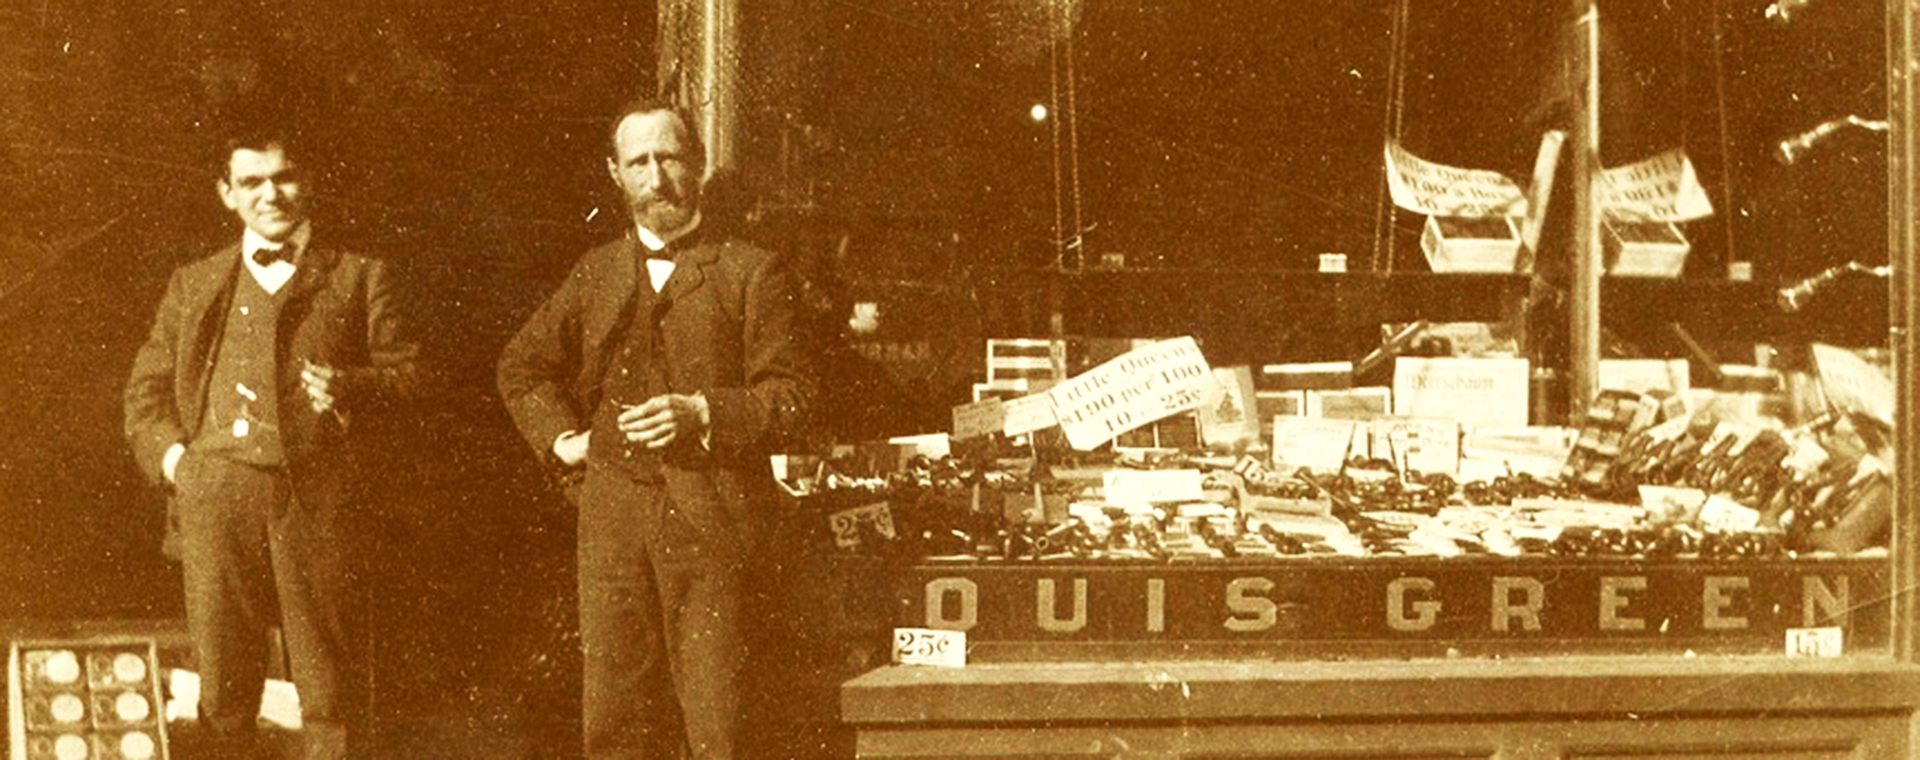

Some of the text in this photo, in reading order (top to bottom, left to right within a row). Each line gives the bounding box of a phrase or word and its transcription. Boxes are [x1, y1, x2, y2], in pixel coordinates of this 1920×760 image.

[1049, 345, 1198, 409] Little Queens
[1121, 373, 1156, 404] per
[1160, 363, 1203, 385] 100
[1104, 410, 1132, 433] 10
[926, 574, 1849, 632] OUIS GREEN
